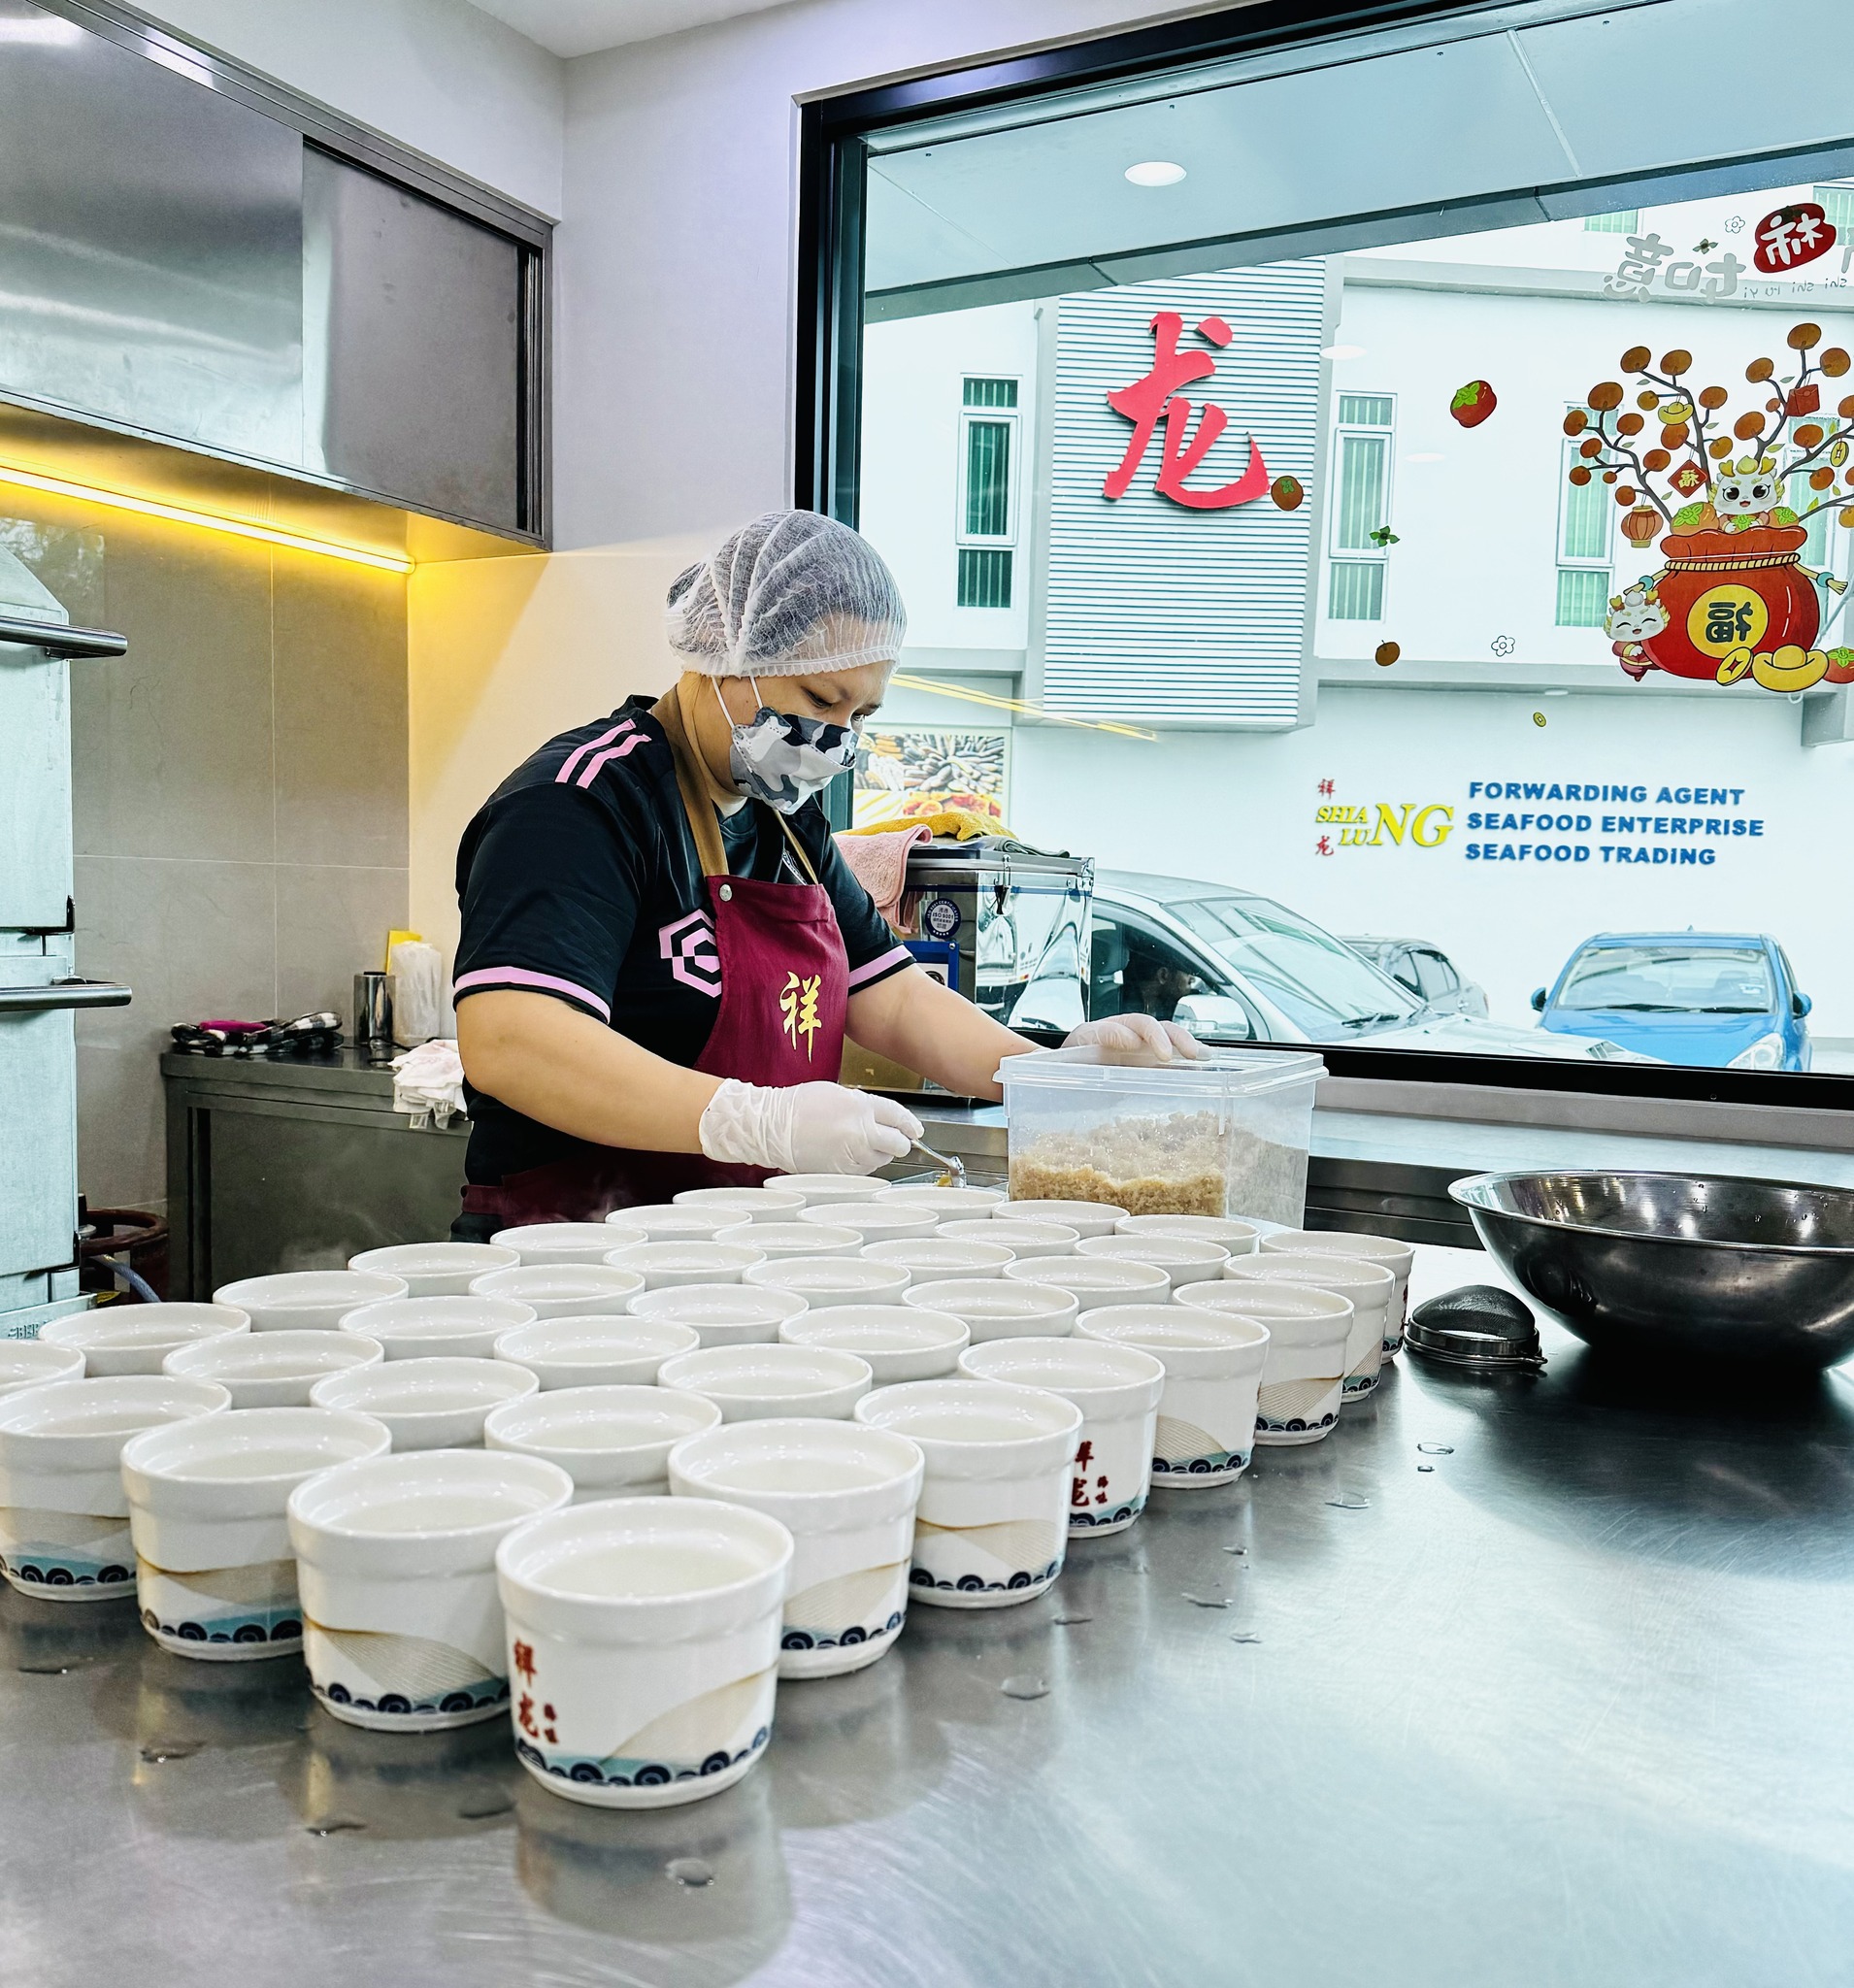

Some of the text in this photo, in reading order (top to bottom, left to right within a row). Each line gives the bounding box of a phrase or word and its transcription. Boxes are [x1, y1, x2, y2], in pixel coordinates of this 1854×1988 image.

[1103, 311, 1270, 509] 龙
[1317, 779, 1336, 800] 祥
[1469, 781, 1745, 806] FORWARDING AGENT
[1467, 812, 1764, 836] SEAFOOD ENTERPRISE
[1465, 843, 1716, 865] SEAFOOD TRADING
[779, 971, 822, 1064] 祥
